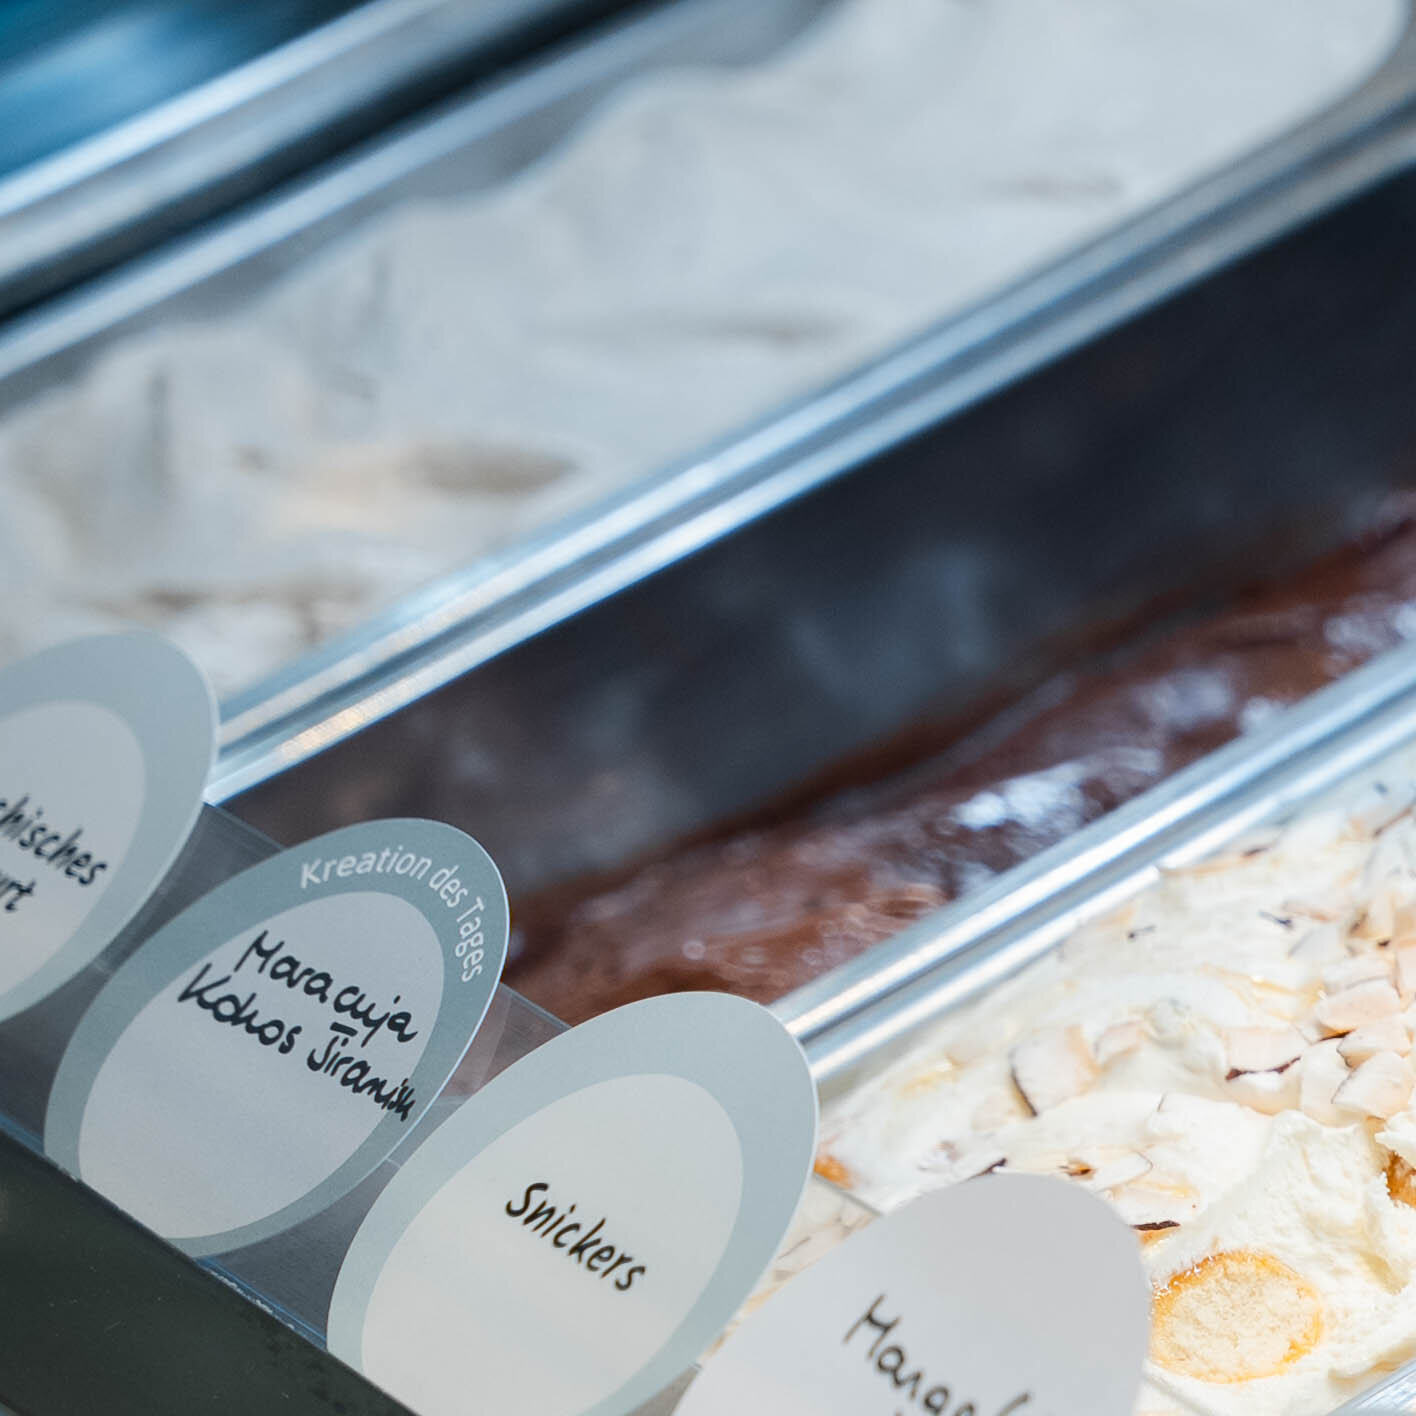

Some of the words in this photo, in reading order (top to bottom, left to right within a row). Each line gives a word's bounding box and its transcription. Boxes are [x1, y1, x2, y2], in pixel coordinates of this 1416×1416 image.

[0, 794, 107, 885] hisches
[300, 845, 433, 889] Kreation
[428, 865, 468, 908] des
[455, 897, 485, 982] Tages
[178, 963, 302, 1054] Kokos
[233, 930, 418, 1048] Maracuja
[505, 1182, 647, 1291] Snickers
